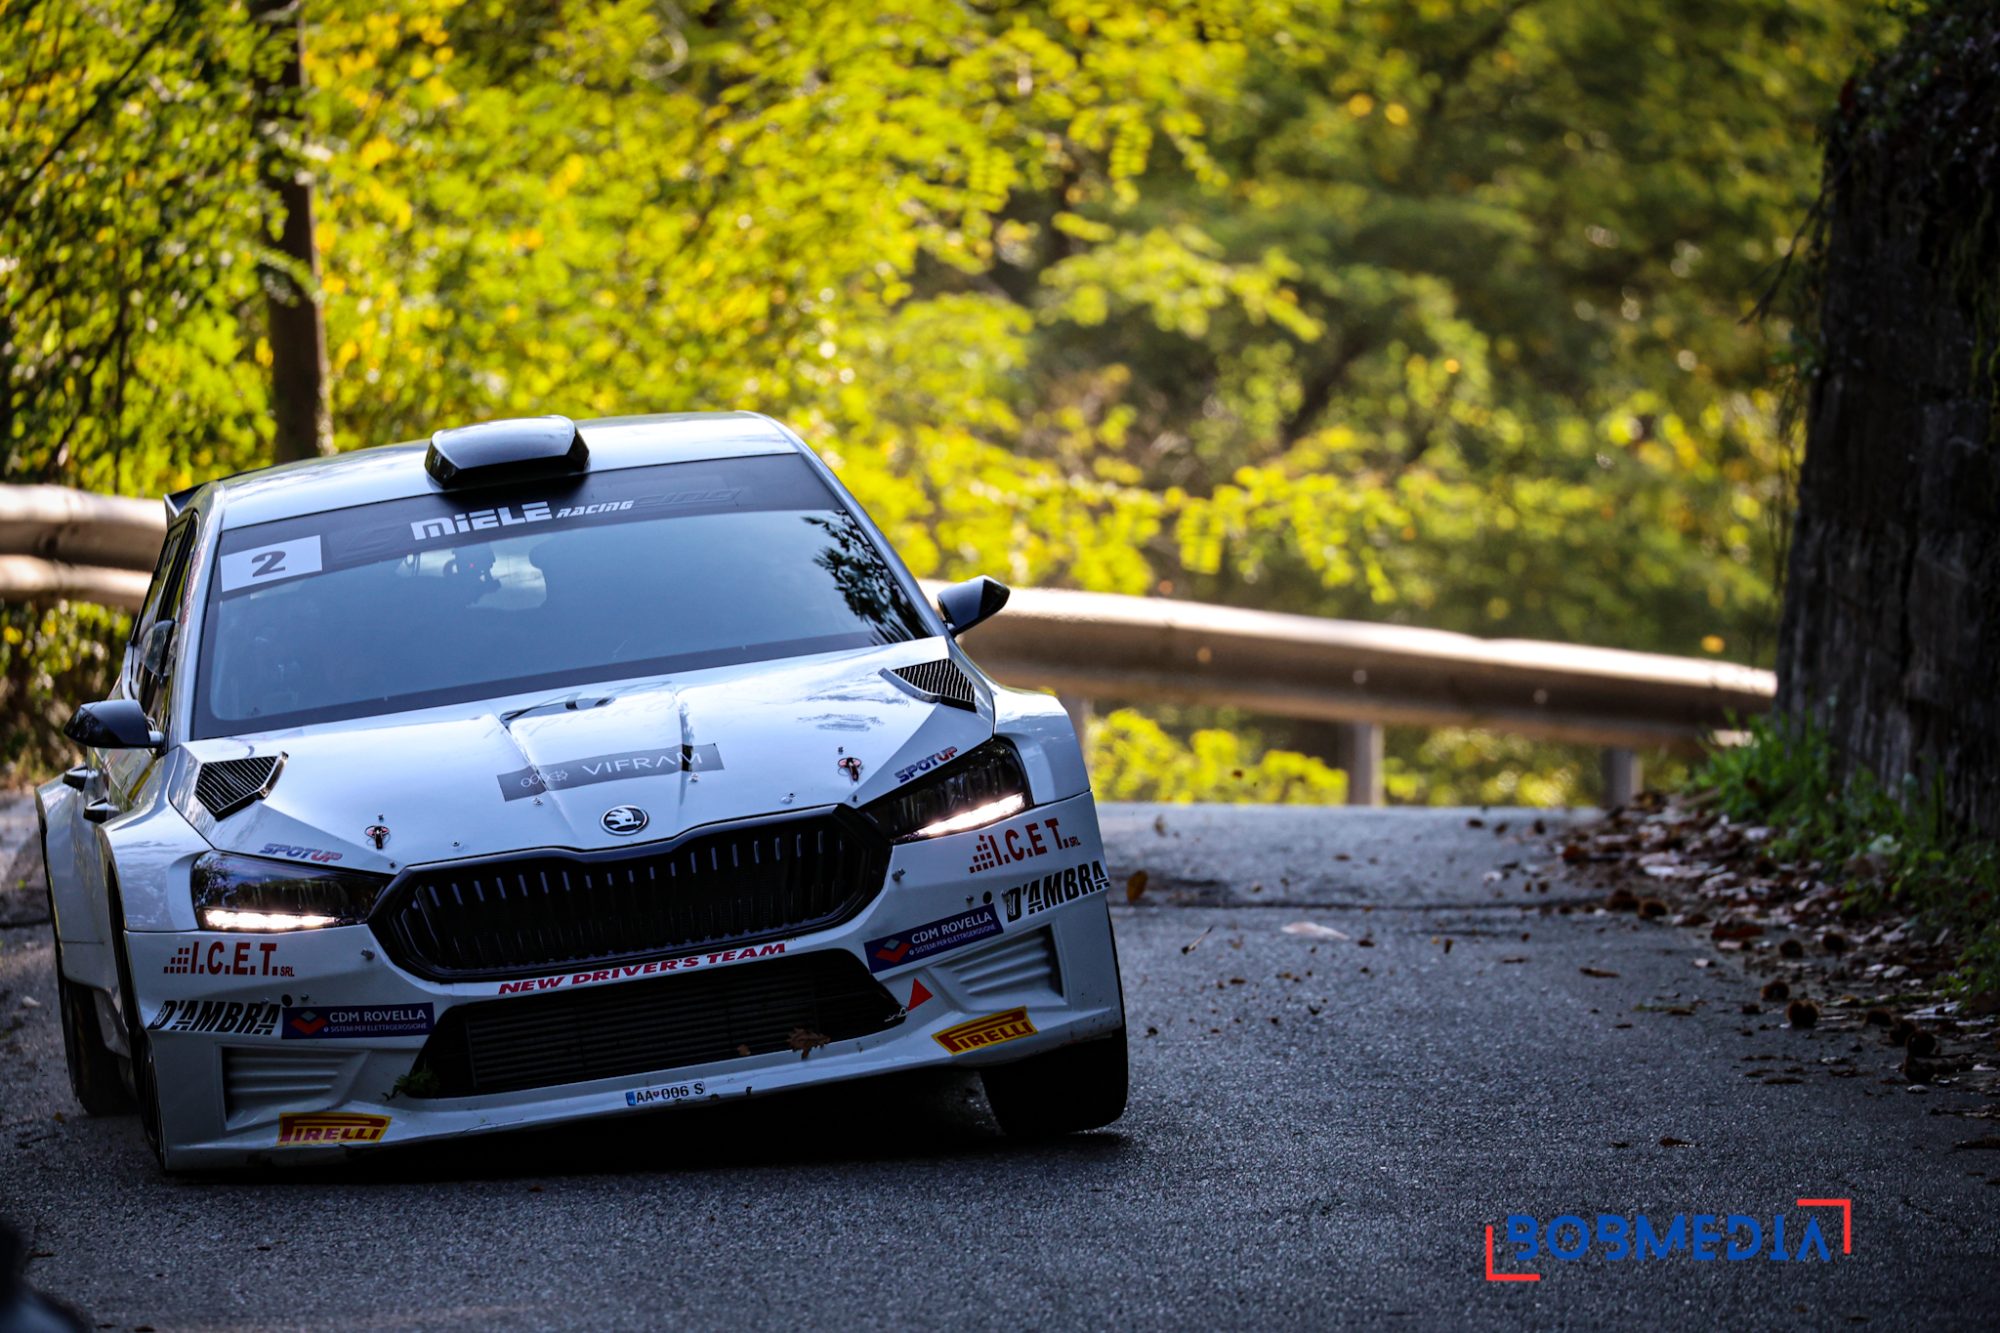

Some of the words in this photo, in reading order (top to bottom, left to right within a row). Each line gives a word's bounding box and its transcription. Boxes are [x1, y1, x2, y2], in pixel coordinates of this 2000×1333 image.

[556, 500, 634, 519] RACING
[252, 551, 286, 577] 2
[582, 752, 703, 776] VIFRAM
[1003, 860, 1110, 922] D'AMBRA
[911, 927, 939, 944] CDM
[941, 911, 993, 935] ROVELLA
[280, 966, 295, 977] SRL
[498, 976, 564, 994] NEW
[571, 956, 699, 985] DRIVER'S
[707, 943, 786, 964] TEAM
[145, 1000, 280, 1035] D'AMBRA
[329, 1011, 360, 1023] CDM
[364, 1009, 427, 1022] ROVELLA
[937, 1010, 1034, 1053] PIRELLI
[661, 1085, 689, 1100] 006
[280, 1115, 386, 1142] PIRELLI
